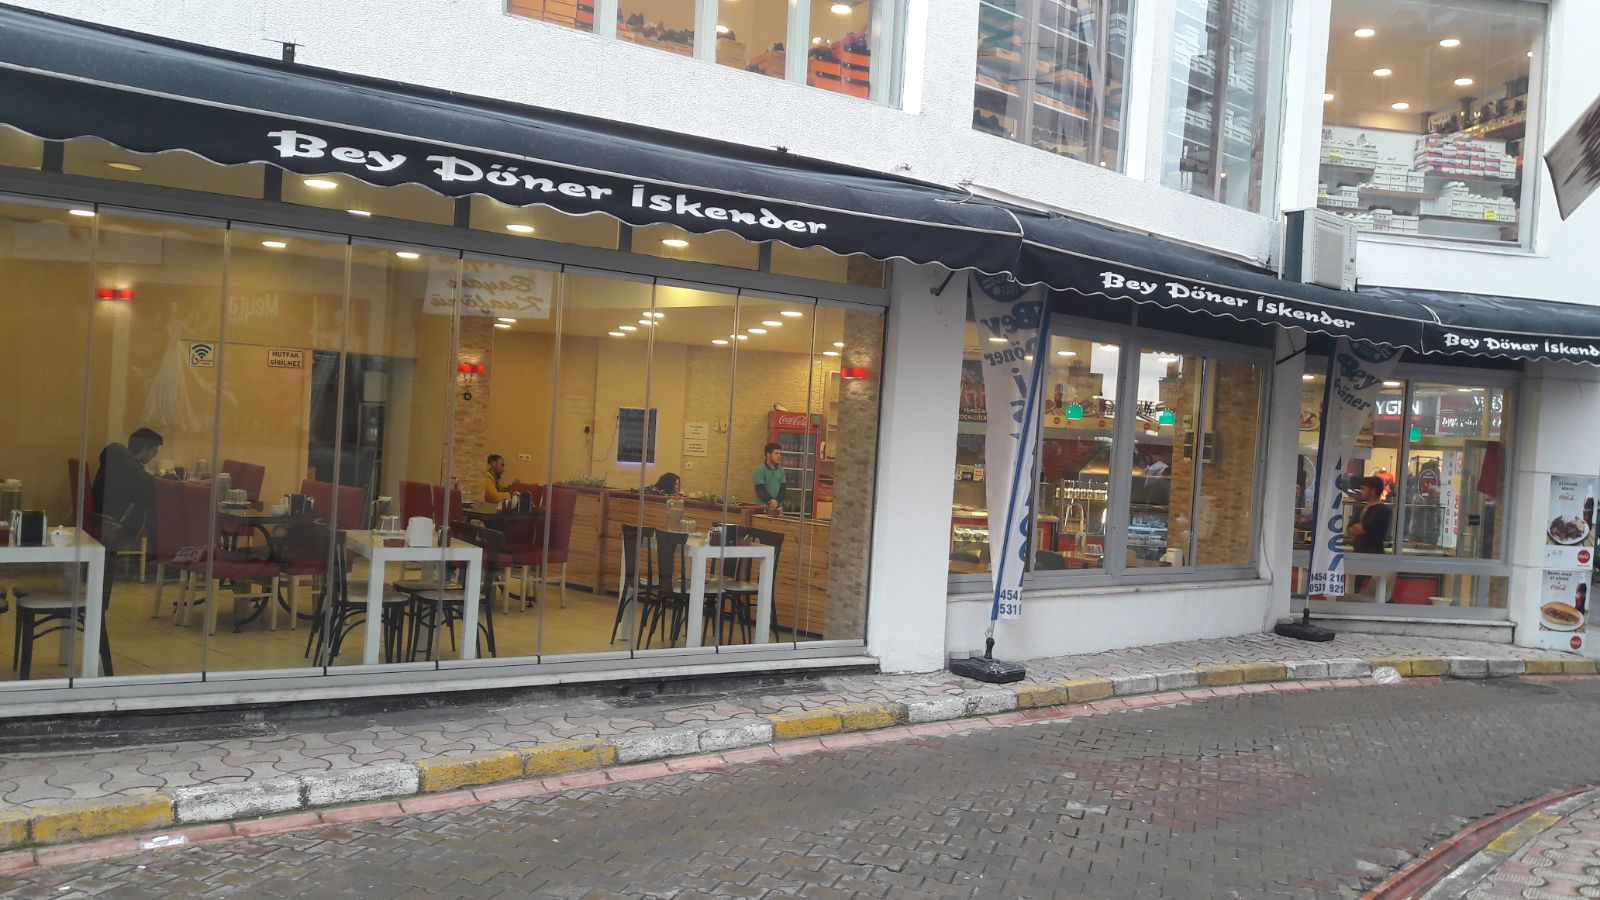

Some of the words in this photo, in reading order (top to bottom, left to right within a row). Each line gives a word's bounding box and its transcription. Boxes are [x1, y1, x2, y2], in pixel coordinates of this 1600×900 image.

[267, 130, 407, 172] Bey
[426, 155, 612, 200] Döner
[632, 184, 827, 234] İskender
[1099, 271, 1158, 295] Bey
[1165, 282, 1248, 307] Döner
[1257, 296, 1356, 328] İskender
[271, 351, 300, 359] MUTFAK
[1443, 333, 1479, 349] Bey
[1483, 337, 1539, 351] Döner
